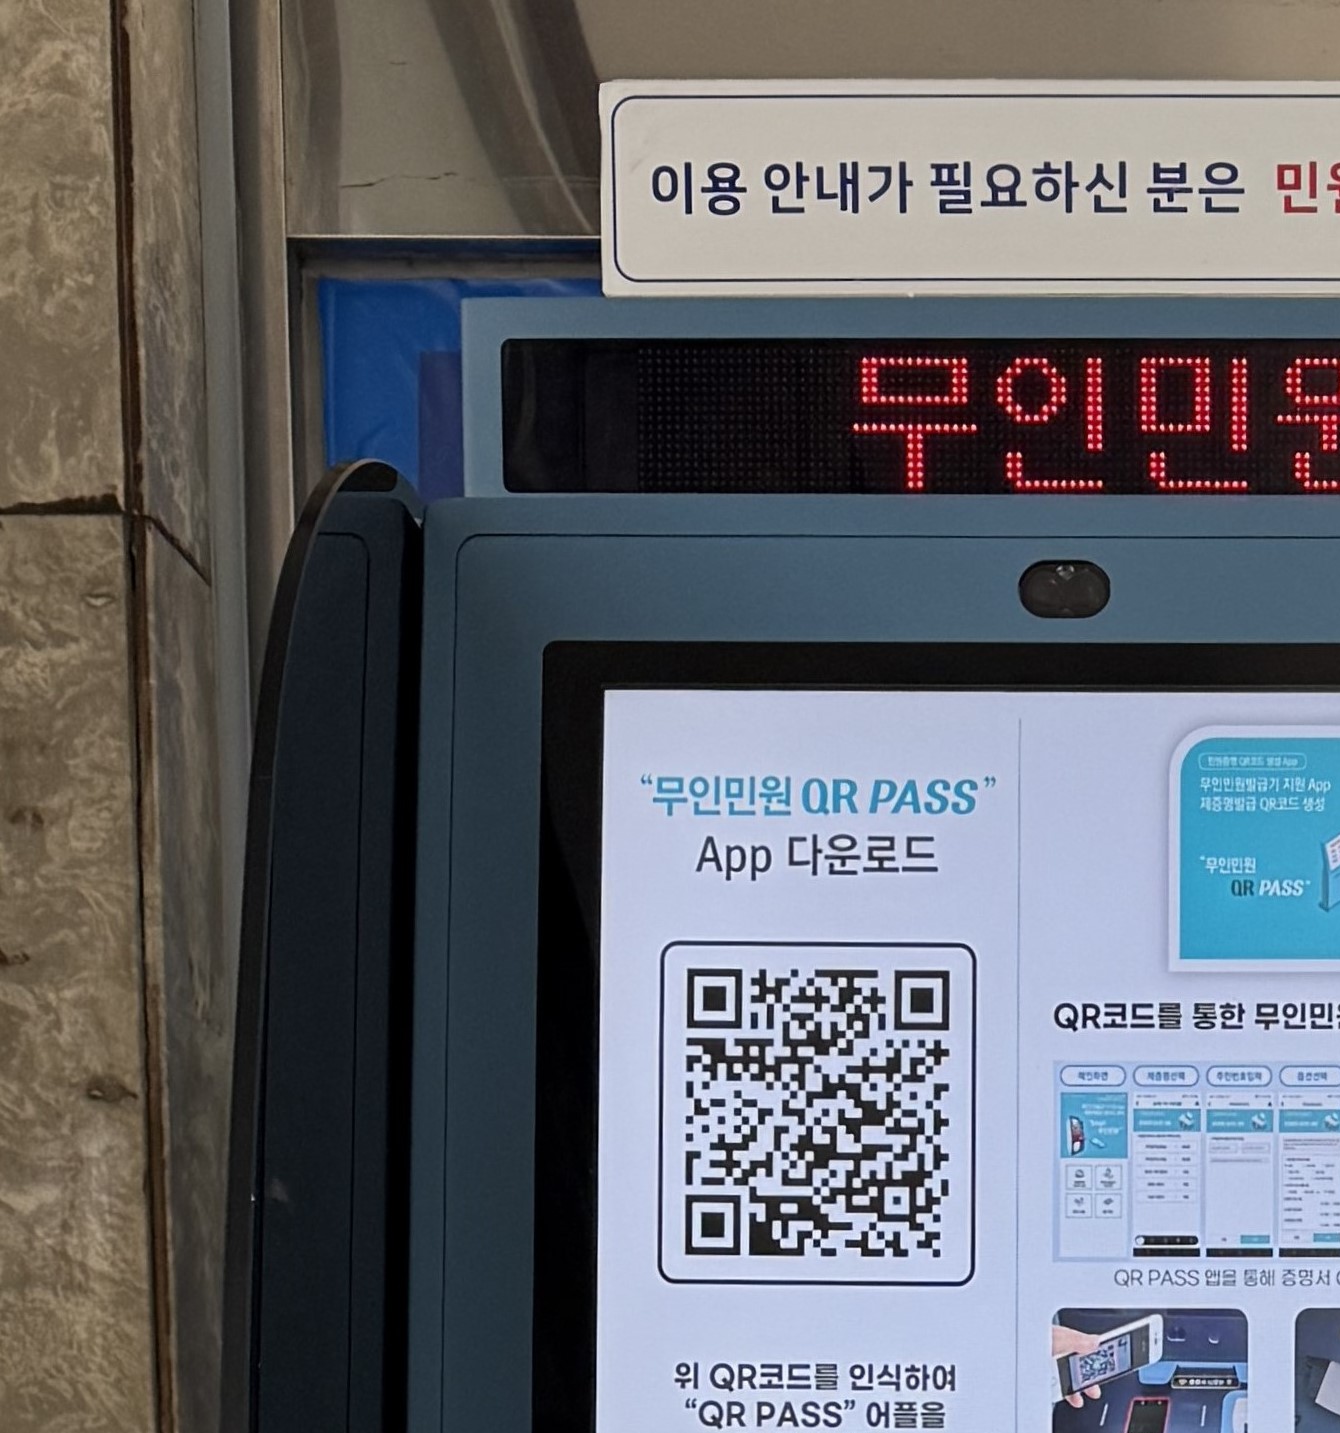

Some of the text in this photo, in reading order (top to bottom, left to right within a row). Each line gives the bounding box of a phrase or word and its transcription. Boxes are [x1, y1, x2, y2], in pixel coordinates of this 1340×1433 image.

[651, 161, 747, 216] 이용
[764, 160, 913, 215] 안내가
[930, 160, 1130, 214] 필요하신
[1146, 160, 1246, 213] 분은
[801, 777, 858, 816] QR
[1308, 778, 1331, 793] App
[696, 834, 939, 881] App 다운로드
[1231, 879, 1254, 897] QR
[1054, 1002, 1182, 1032] QR코드를
[1192, 1002, 1245, 1030] 통한
[1114, 1269, 1143, 1287] QR
[1148, 1269, 1199, 1286] PASS
[1281, 1269, 1330, 1287] 증명서
[674, 1362, 957, 1393] 위 QR코드를 인식하여
[866, 1401, 946, 1429] 어플을
